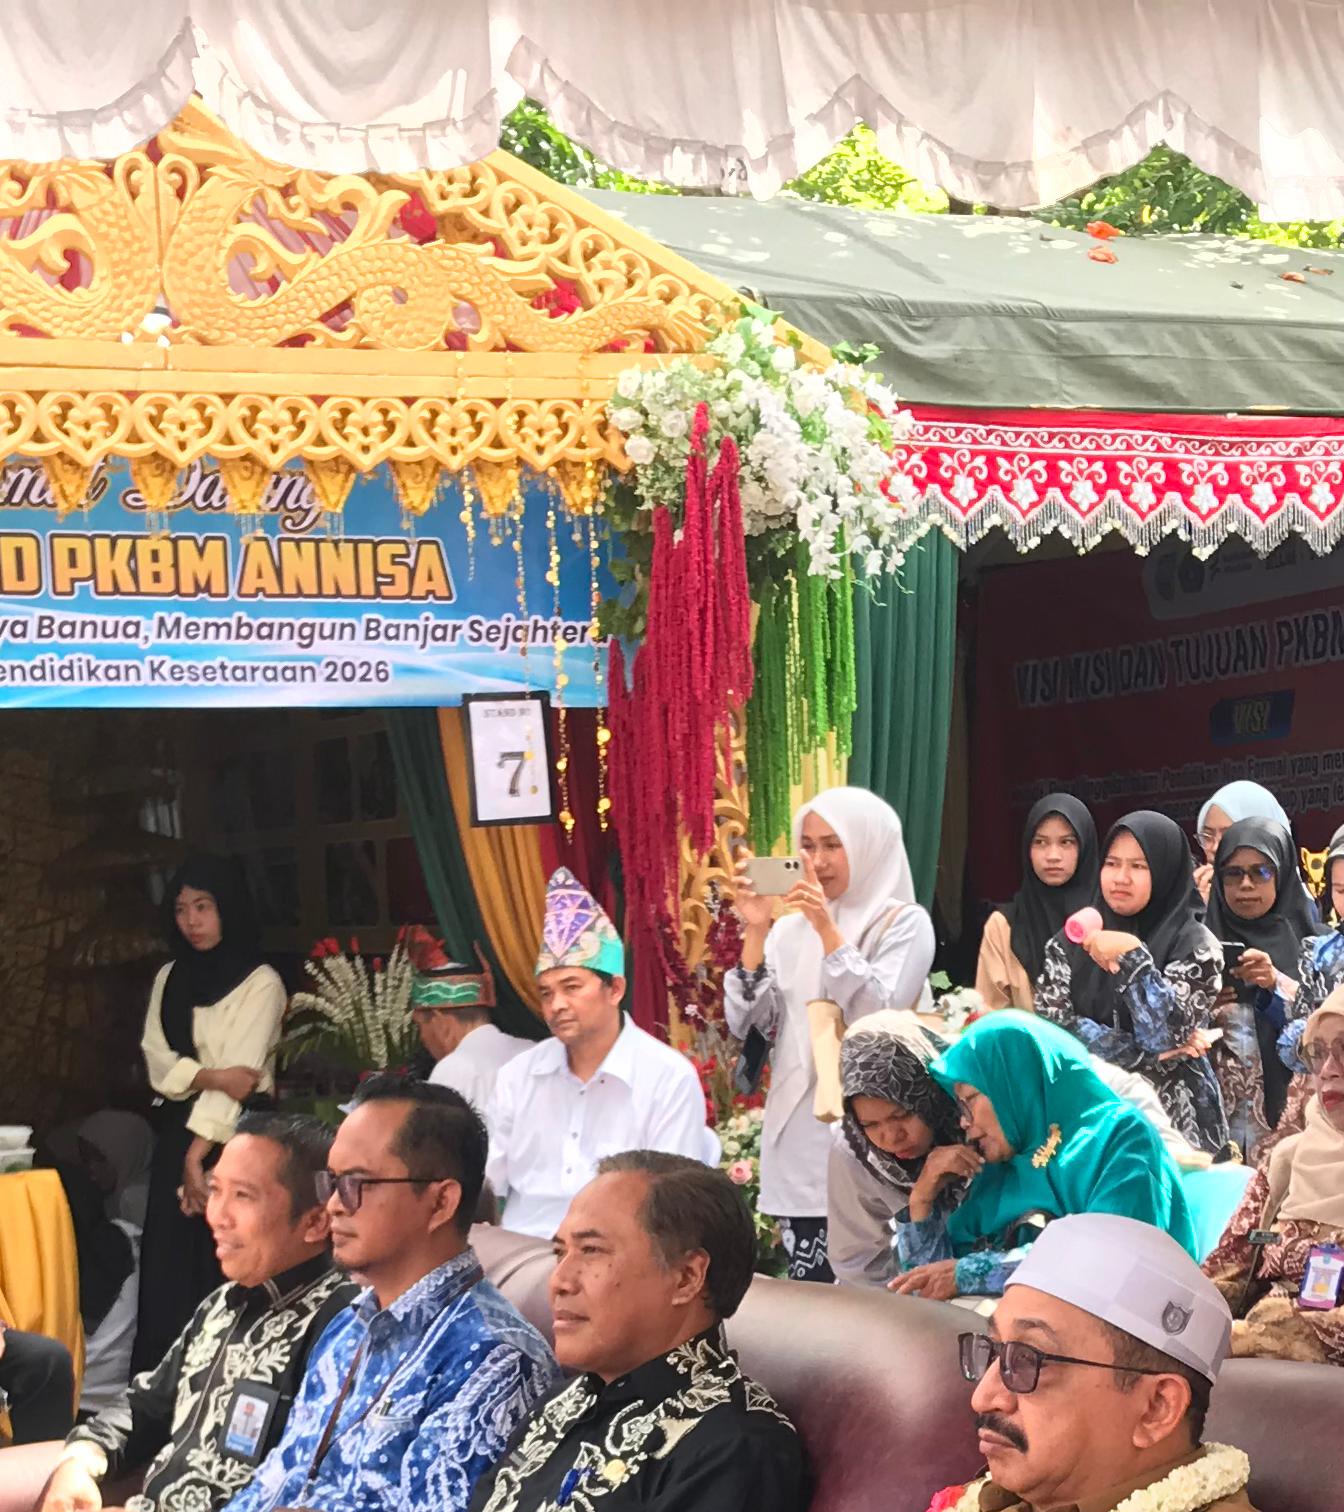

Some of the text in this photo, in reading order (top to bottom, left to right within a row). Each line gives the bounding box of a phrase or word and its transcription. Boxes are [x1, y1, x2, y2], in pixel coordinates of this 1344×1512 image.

[51, 533, 230, 598] PKBM
[238, 536, 454, 601] ANNISA
[37, 614, 150, 643] Banua,
[157, 615, 355, 649] Membangun
[364, 617, 462, 650] Banjar
[1170, 624, 1268, 682] TUJUAN
[150, 660, 317, 683] Kesetaraan
[324, 661, 390, 684] 2026
[497, 751, 527, 797] 7
